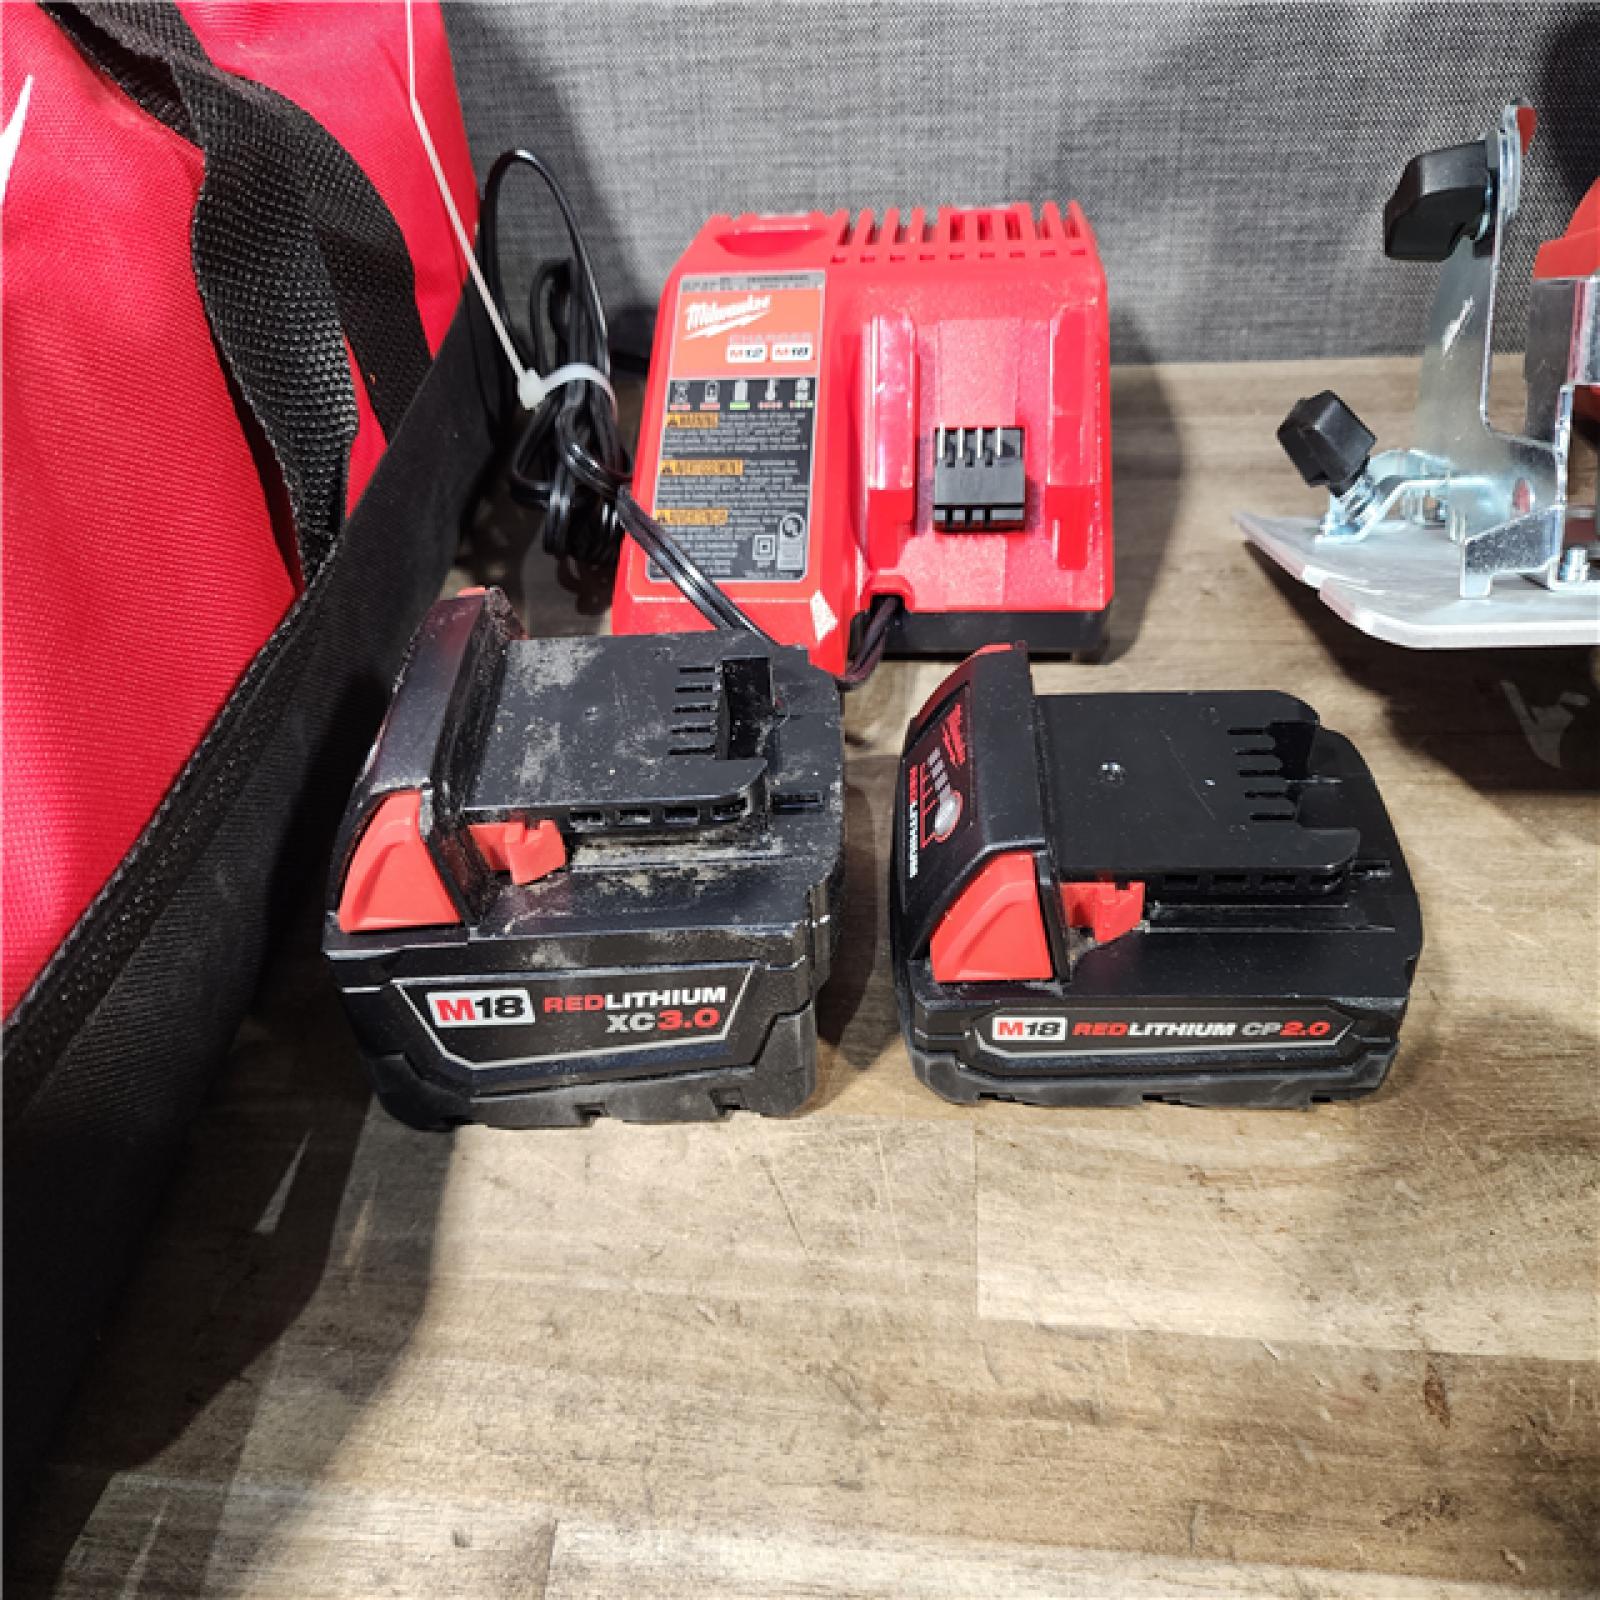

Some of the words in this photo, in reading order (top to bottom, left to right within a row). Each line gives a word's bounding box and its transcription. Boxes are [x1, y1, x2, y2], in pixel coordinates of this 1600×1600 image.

[435, 996, 526, 1022] M18
[543, 986, 727, 1014] REDLITHIUM
[605, 1007, 721, 1034] XC3.0
[997, 1021, 1061, 1037] M18
[1071, 1021, 1236, 1037] REDLITHIUM
[1240, 1021, 1331, 1037] CP2.0
